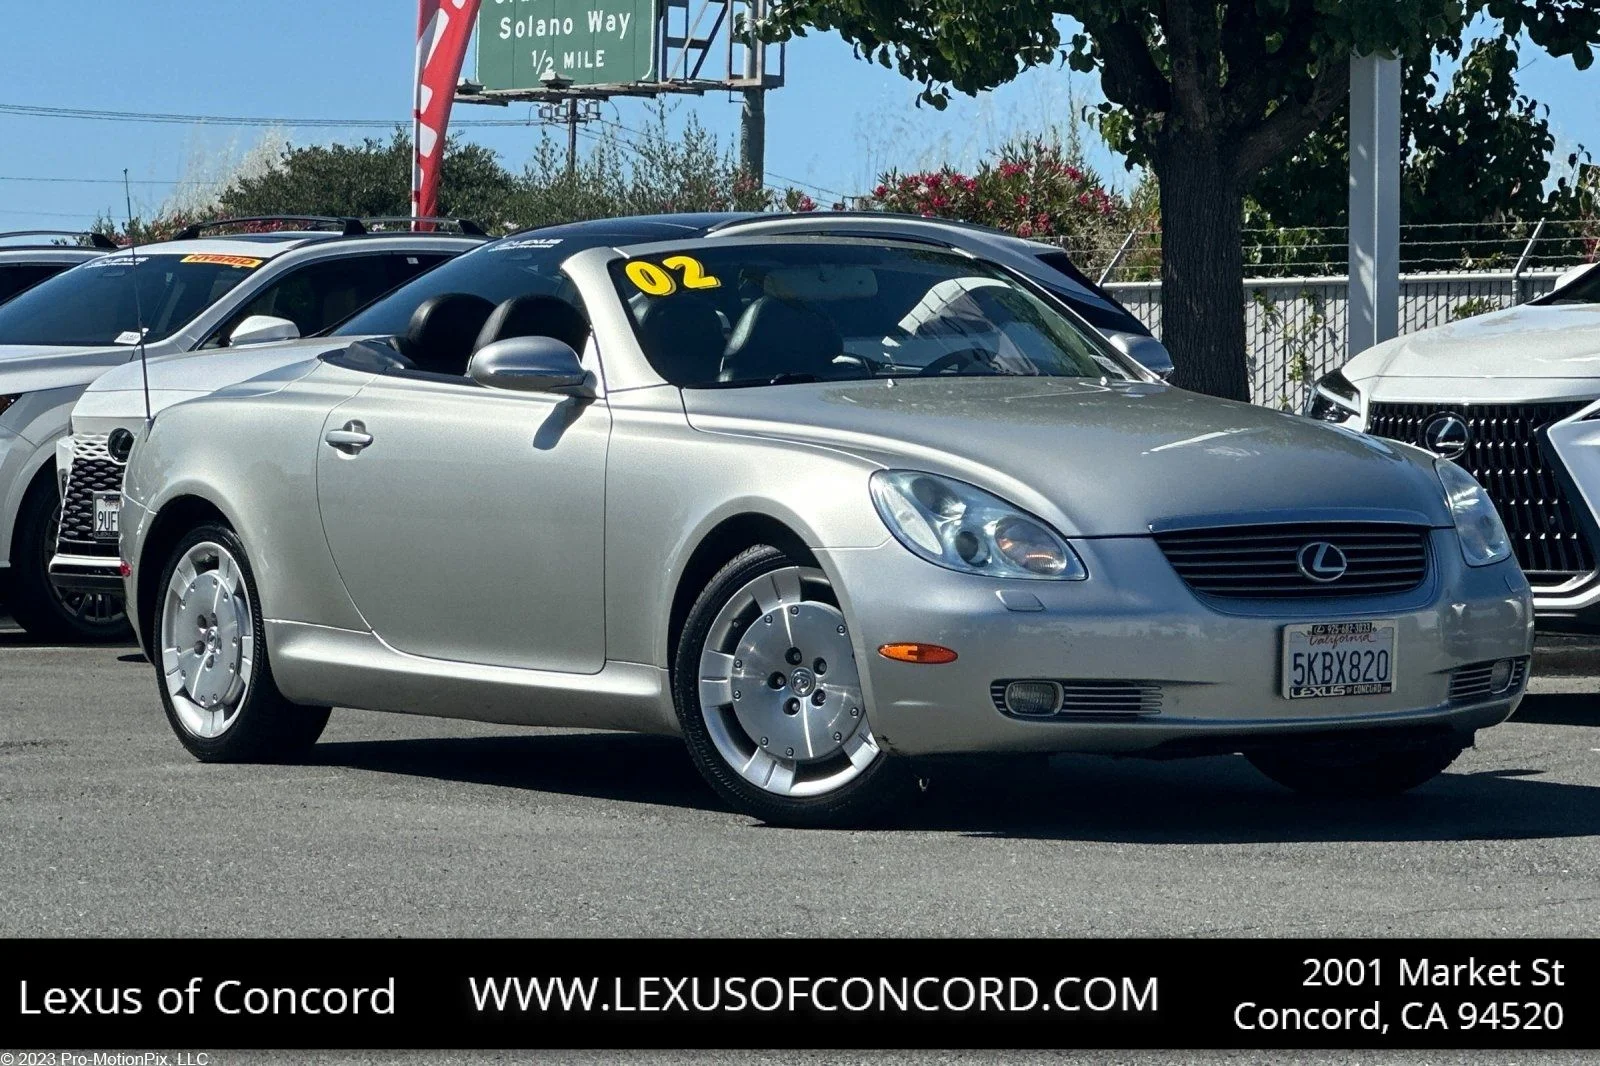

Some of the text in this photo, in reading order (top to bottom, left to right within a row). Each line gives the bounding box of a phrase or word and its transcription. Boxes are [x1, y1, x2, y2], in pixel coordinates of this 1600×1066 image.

[499, 10, 631, 40] Solano Way
[563, 50, 605, 70] MILE
[188, 255, 255, 265] HYBRID
[625, 255, 721, 296] 02
[1309, 633, 1376, 649] California
[1293, 649, 1389, 686] 5KBX820
[1290, 685, 1346, 698] LEXUS
